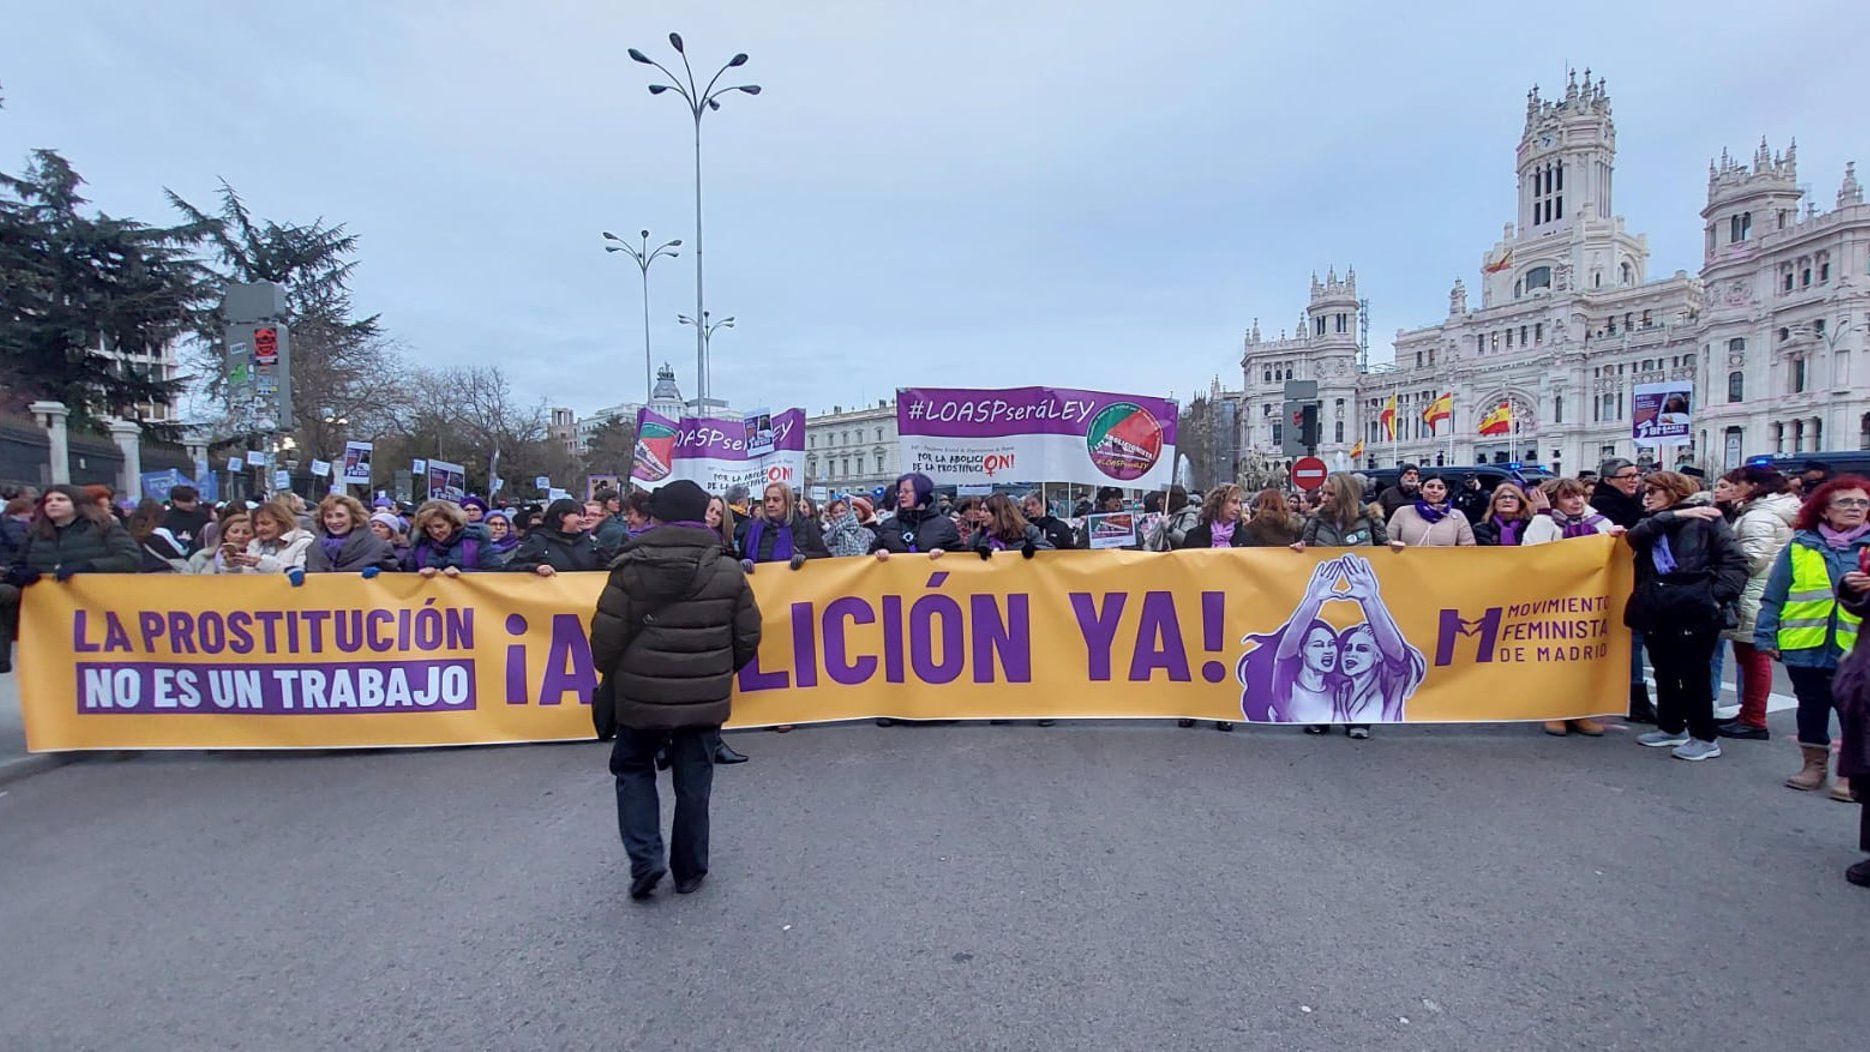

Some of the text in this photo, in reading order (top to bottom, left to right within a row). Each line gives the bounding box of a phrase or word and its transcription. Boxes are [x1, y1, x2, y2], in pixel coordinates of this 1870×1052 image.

[908, 400, 1095, 423] #LOASPseráLEY
[925, 463, 934, 471] LA
[935, 454, 945, 463] LA
[1507, 595, 1609, 618] MOVIMIENTO
[73, 597, 475, 655] LA PROSTITUCIÓN
[1068, 590, 1227, 684] YA!
[1502, 619, 1608, 641] FEMINISTA
[1500, 643, 1608, 663] DE MADRID
[84, 664, 470, 710] NO ES UN TRABAJO
